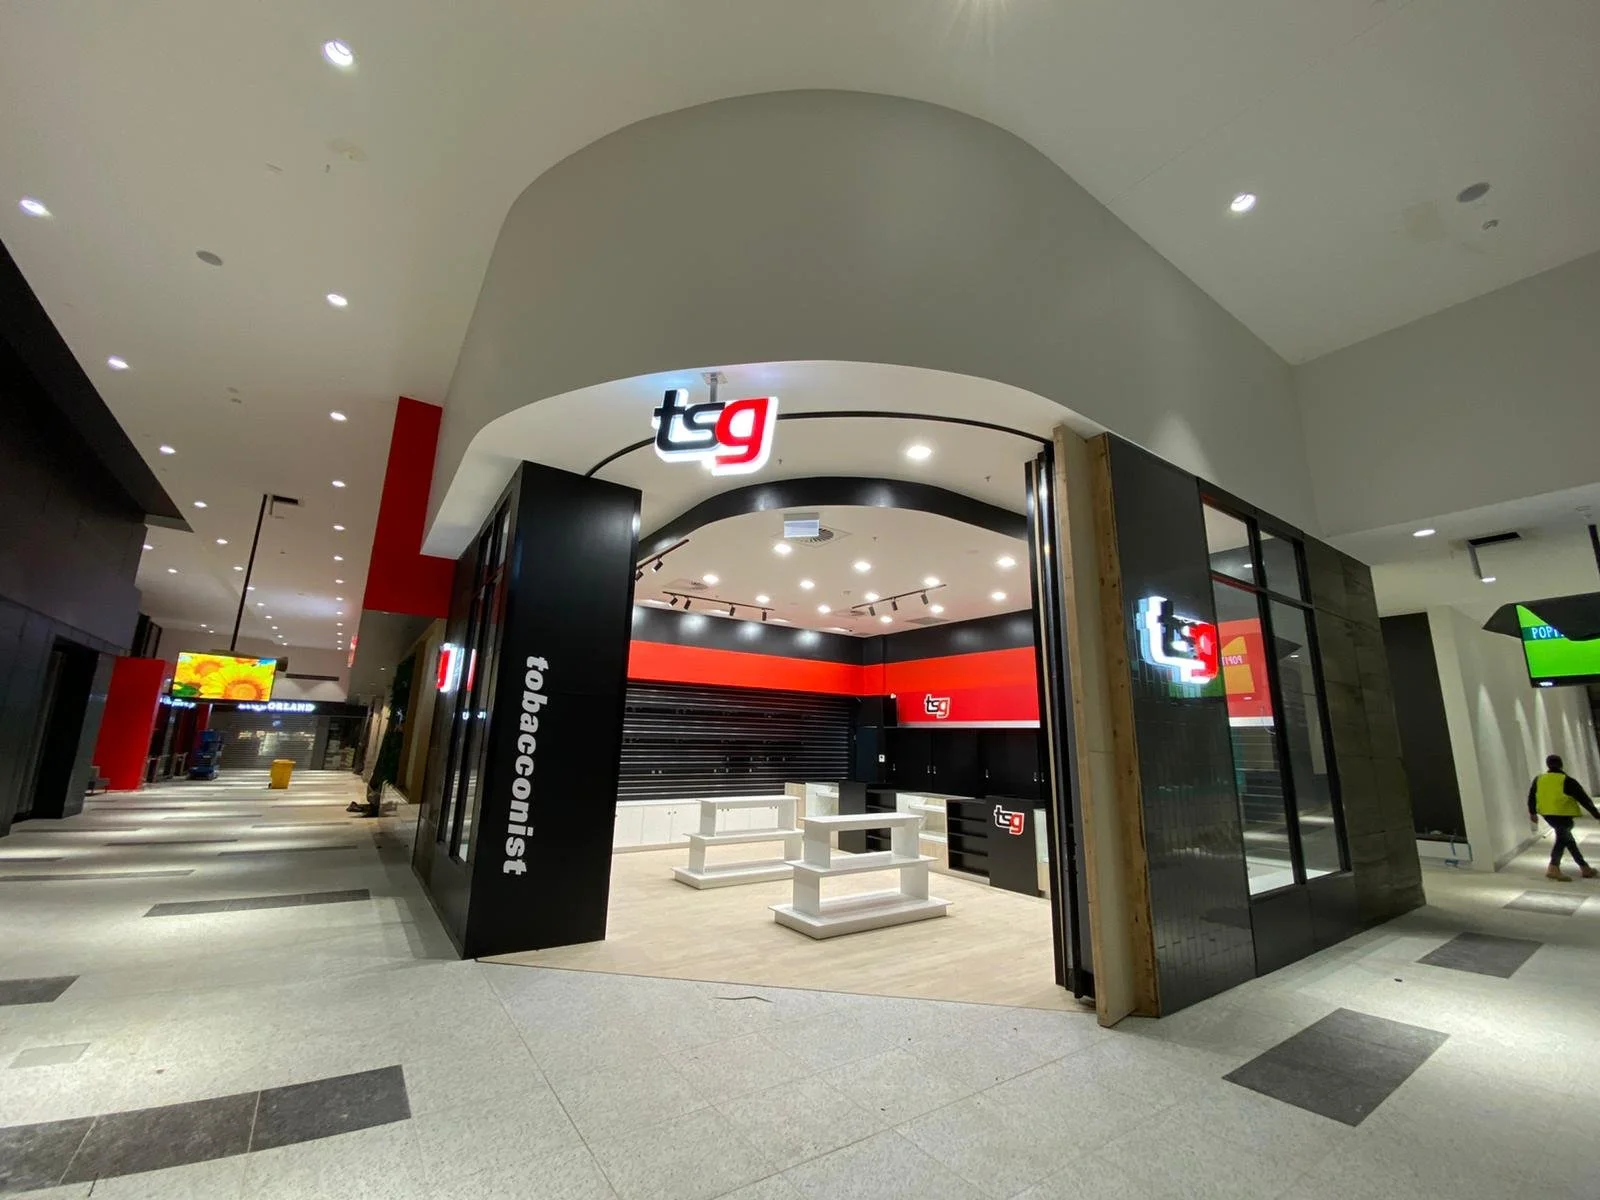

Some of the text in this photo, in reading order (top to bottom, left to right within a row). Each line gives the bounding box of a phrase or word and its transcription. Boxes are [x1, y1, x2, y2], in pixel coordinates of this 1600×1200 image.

[654, 390, 770, 467] tsg
[1531, 626, 1565, 639] POPI
[925, 695, 949, 718] tsg
[503, 656, 549, 875] tobacconist
[994, 806, 1024, 834] tsg
